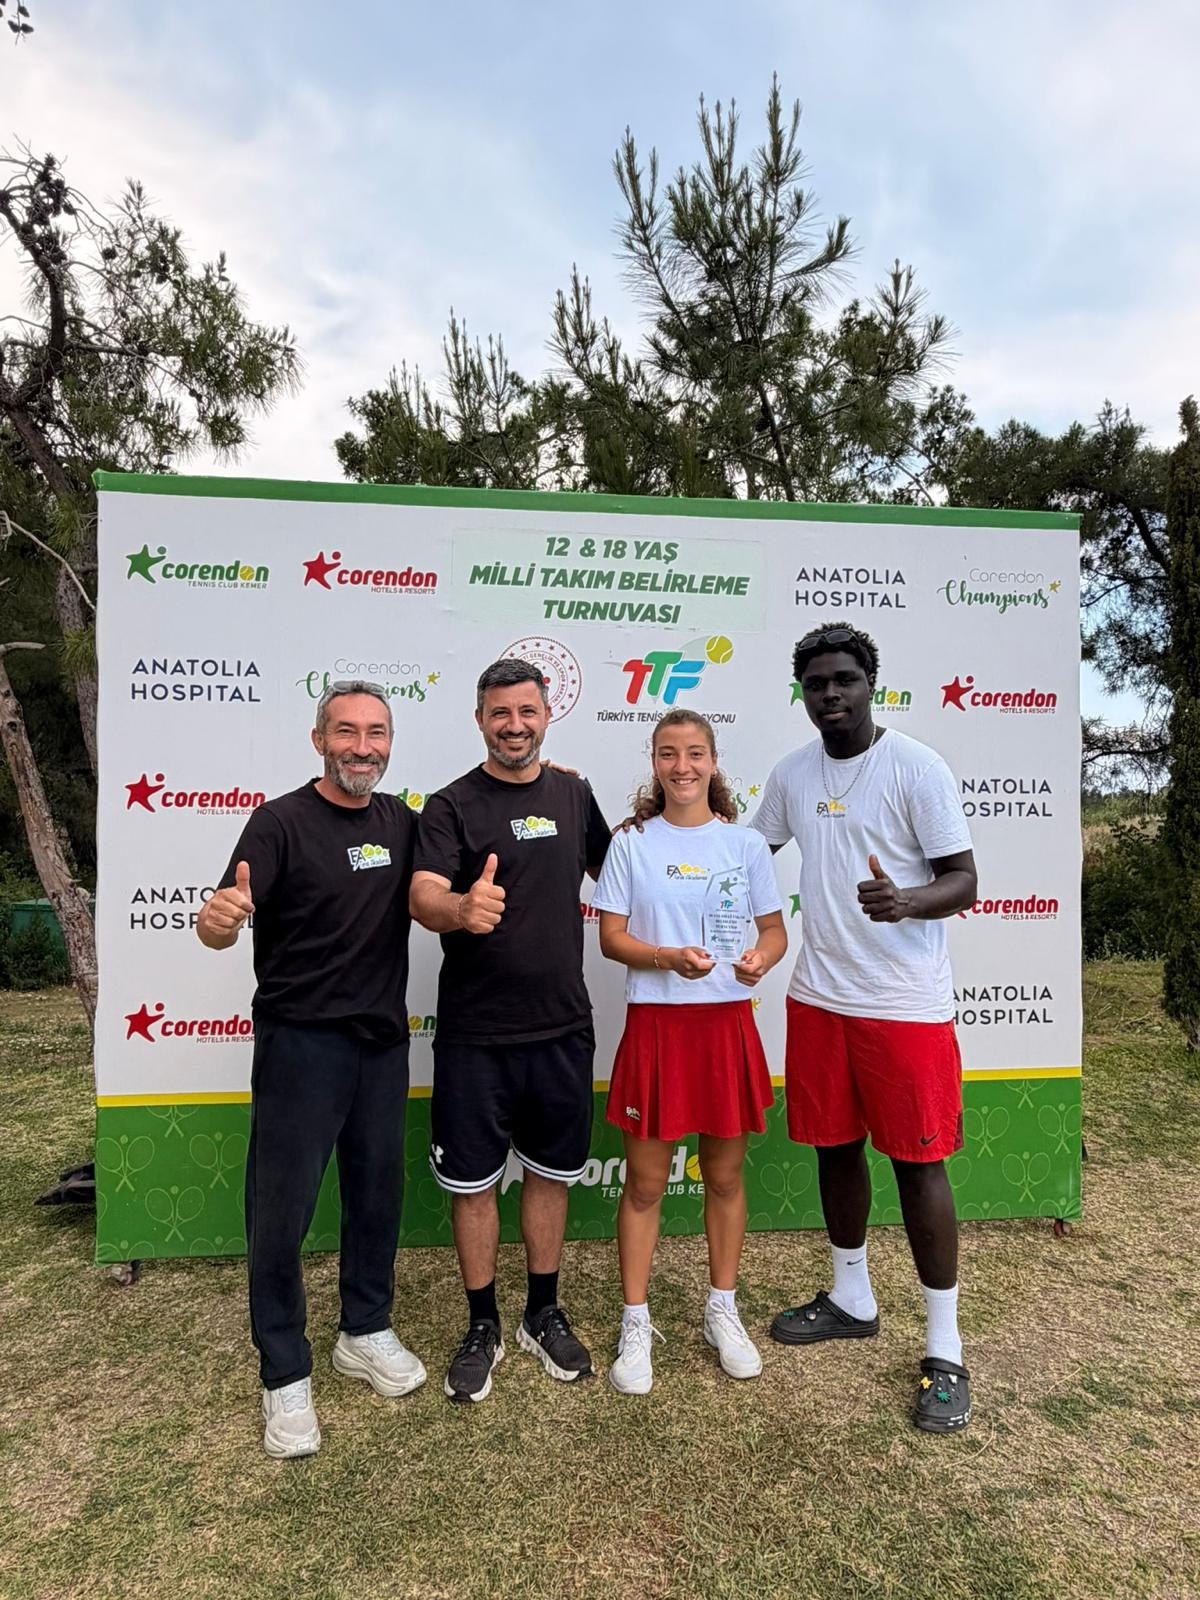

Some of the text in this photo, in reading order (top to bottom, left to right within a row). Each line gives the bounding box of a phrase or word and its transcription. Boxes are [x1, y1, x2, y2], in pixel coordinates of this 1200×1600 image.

[546, 537, 679, 565] 12 & 18 YAŞ
[337, 566, 438, 588] corendon
[469, 561, 750, 596] MİLLİ TAKIM BELİRLEME
[796, 567, 906, 585] ANATOLIA
[969, 568, 1044, 584] Corendon
[795, 590, 906, 608] HOSPITAL
[936, 579, 1050, 614] Champions
[543, 599, 681, 624] TURNUVASI
[132, 658, 261, 677] ANATOLIA
[334, 658, 421, 675] Corendon
[296, 670, 427, 703] Chions
[622, 650, 706, 705] TTF
[131, 683, 261, 702] HOSPITAL
[971, 688, 1057, 707] corendon
[596, 710, 663, 722] TÜRKİYE TENİS
[962, 778, 1052, 794] NATOLIA
[962, 801, 1053, 817] OSPITAL
[131, 887, 218, 904] ANATO
[971, 894, 1059, 914] corendon
[161, 1014, 255, 1036] corendo
